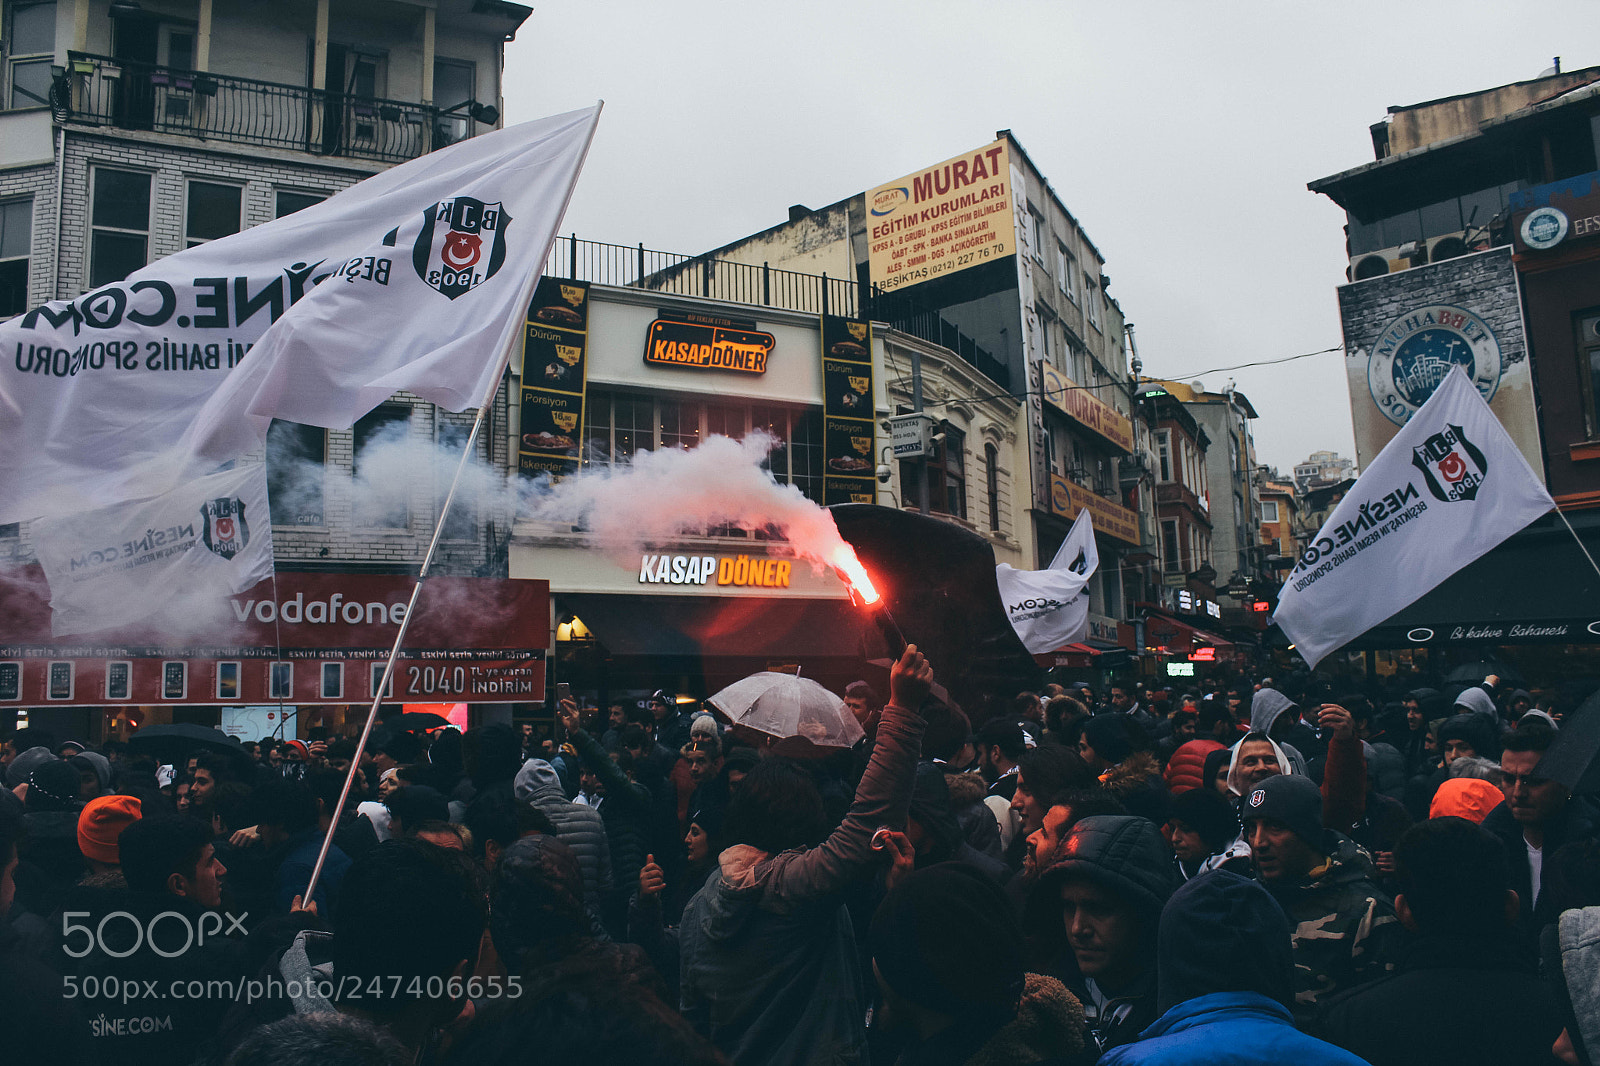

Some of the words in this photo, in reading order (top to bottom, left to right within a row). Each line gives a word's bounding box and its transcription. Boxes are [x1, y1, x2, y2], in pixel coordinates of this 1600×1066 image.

[913, 146, 1003, 204] MURAT
[873, 213, 919, 239] EĞİTİM
[920, 182, 1005, 223] KURUMLARI
[874, 191, 899, 206] MURAT
[873, 241, 889, 254] KPSS
[890, 239, 895, 248] A
[904, 228, 927, 243] GRUBU
[931, 220, 948, 234] KPSS
[973, 197, 1008, 220] BİLİMLERİ
[913, 241, 926, 253] SPK
[930, 232, 953, 247] BANKA
[954, 220, 989, 240] SINAVLARI
[887, 262, 902, 274] ALES
[931, 247, 945, 260] DGS
[951, 230, 997, 255] AÇIKÖĞRETİM
[880, 267, 928, 290] BEŞİKTAŞ
[930, 260, 955, 276] (0212)
[957, 252, 974, 266] 227
[978, 247, 990, 259] 76
[992, 243, 1004, 255] 70
[530, 327, 562, 342] Dürüm
[653, 339, 711, 365] KASAP
[711, 345, 766, 372] DÖNER
[827, 362, 853, 374] Dürüm
[525, 392, 568, 408] Porsiyon
[1064, 382, 1102, 431] MURAT
[828, 421, 863, 434] Porsiyon
[297, 514, 320, 523] cafe
[639, 554, 717, 585] KASAP
[717, 554, 792, 588] DÖNER
[230, 592, 409, 625] vodafone
[1450, 626, 1465, 640] Bi
[1465, 625, 1503, 639] kahve
[1508, 623, 1569, 638] Bahanesi
[288, 650, 316, 658] ESKİYİ
[319, 649, 346, 659] GETİR,
[347, 649, 376, 658] YENİYİ
[421, 650, 447, 659] ESKİYİ
[409, 666, 465, 694] 2040
[469, 666, 484, 676] TL
[486, 667, 499, 678] ye
[501, 667, 533, 676] varan
[472, 677, 532, 694] İNDİRİM
